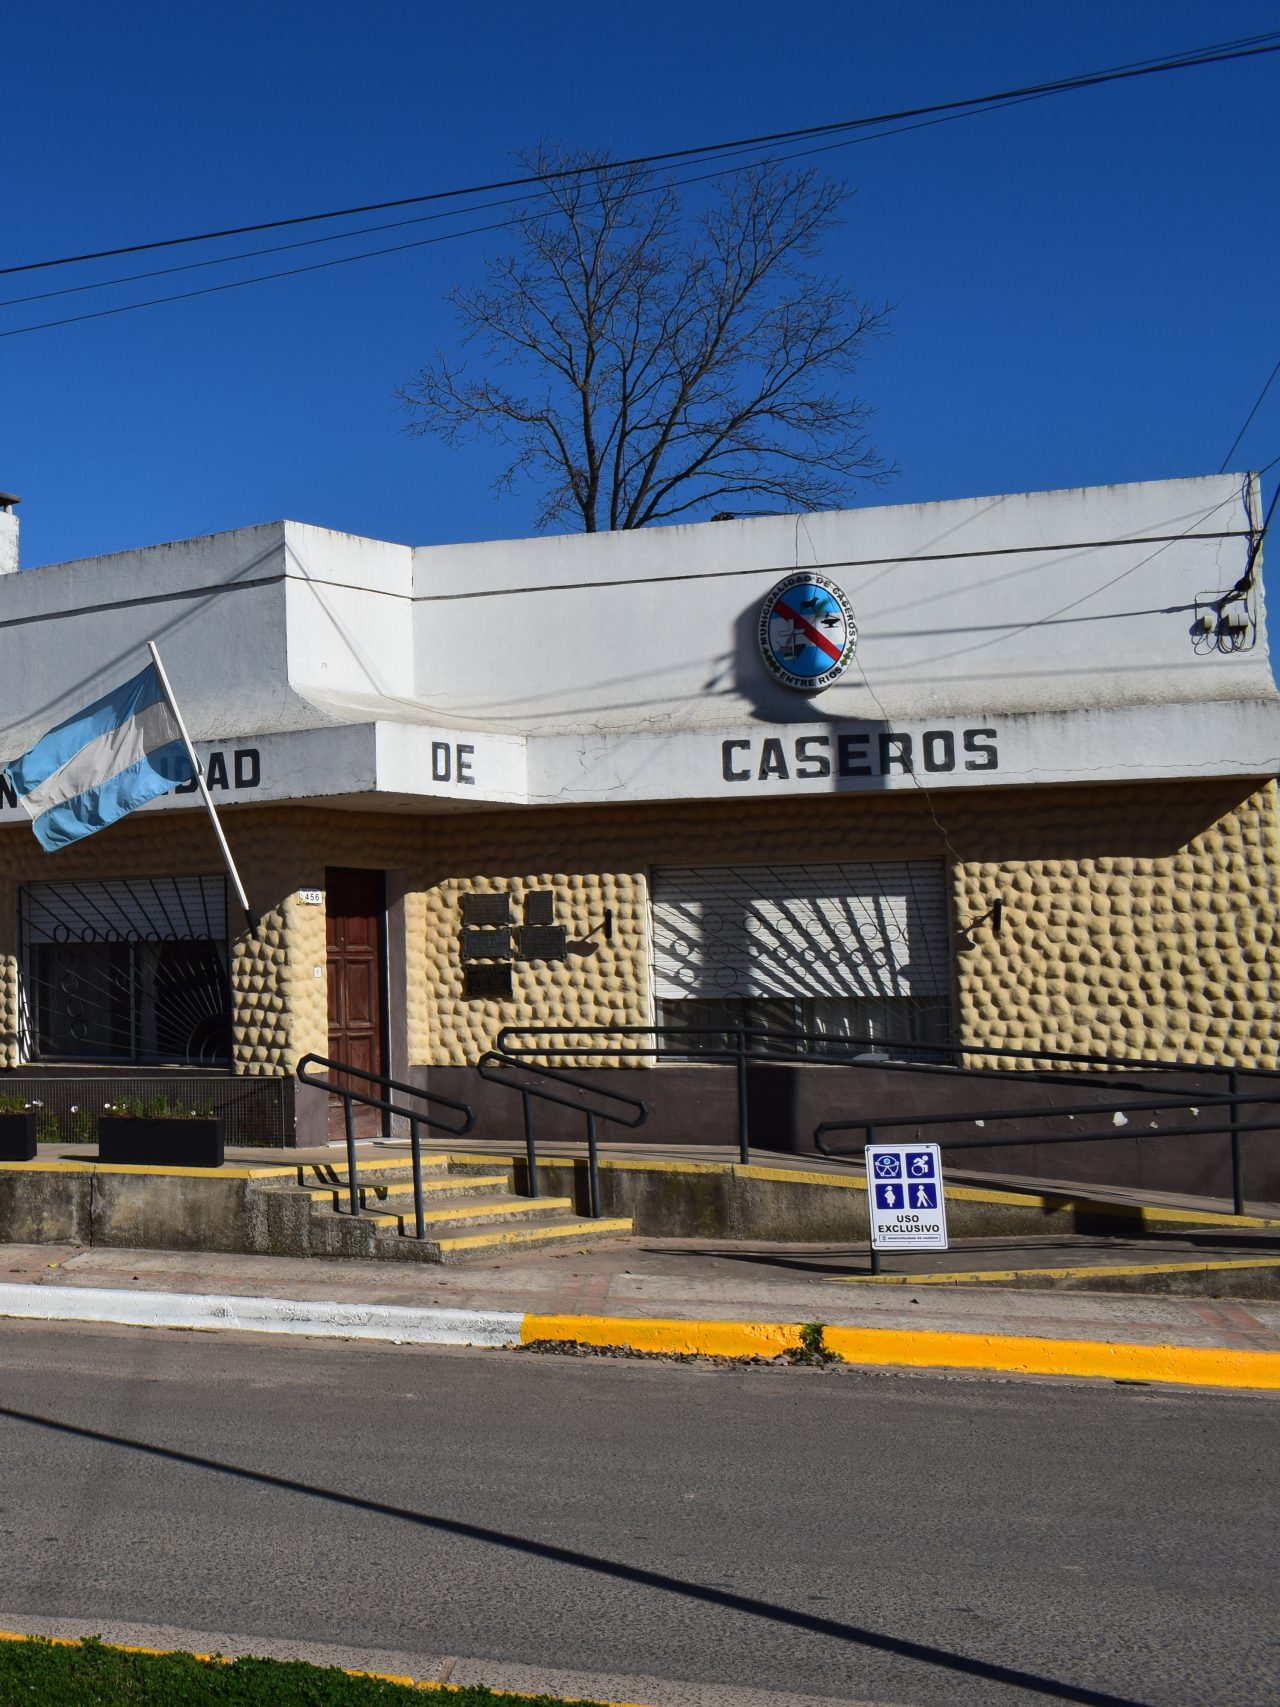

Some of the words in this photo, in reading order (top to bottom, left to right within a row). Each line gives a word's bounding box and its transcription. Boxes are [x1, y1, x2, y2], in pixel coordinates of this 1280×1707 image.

[760, 575, 812, 646] MUNICIPALIDAD
[816, 577, 831, 588] DE
[832, 586, 856, 637] CASEROS
[780, 672, 816, 687] ENTRE
[818, 666, 843, 685] RIOS
[431, 741, 475, 784] DE
[721, 728, 999, 782] CASEROS
[878, 1224, 940, 1232] EXCLUSIVO
